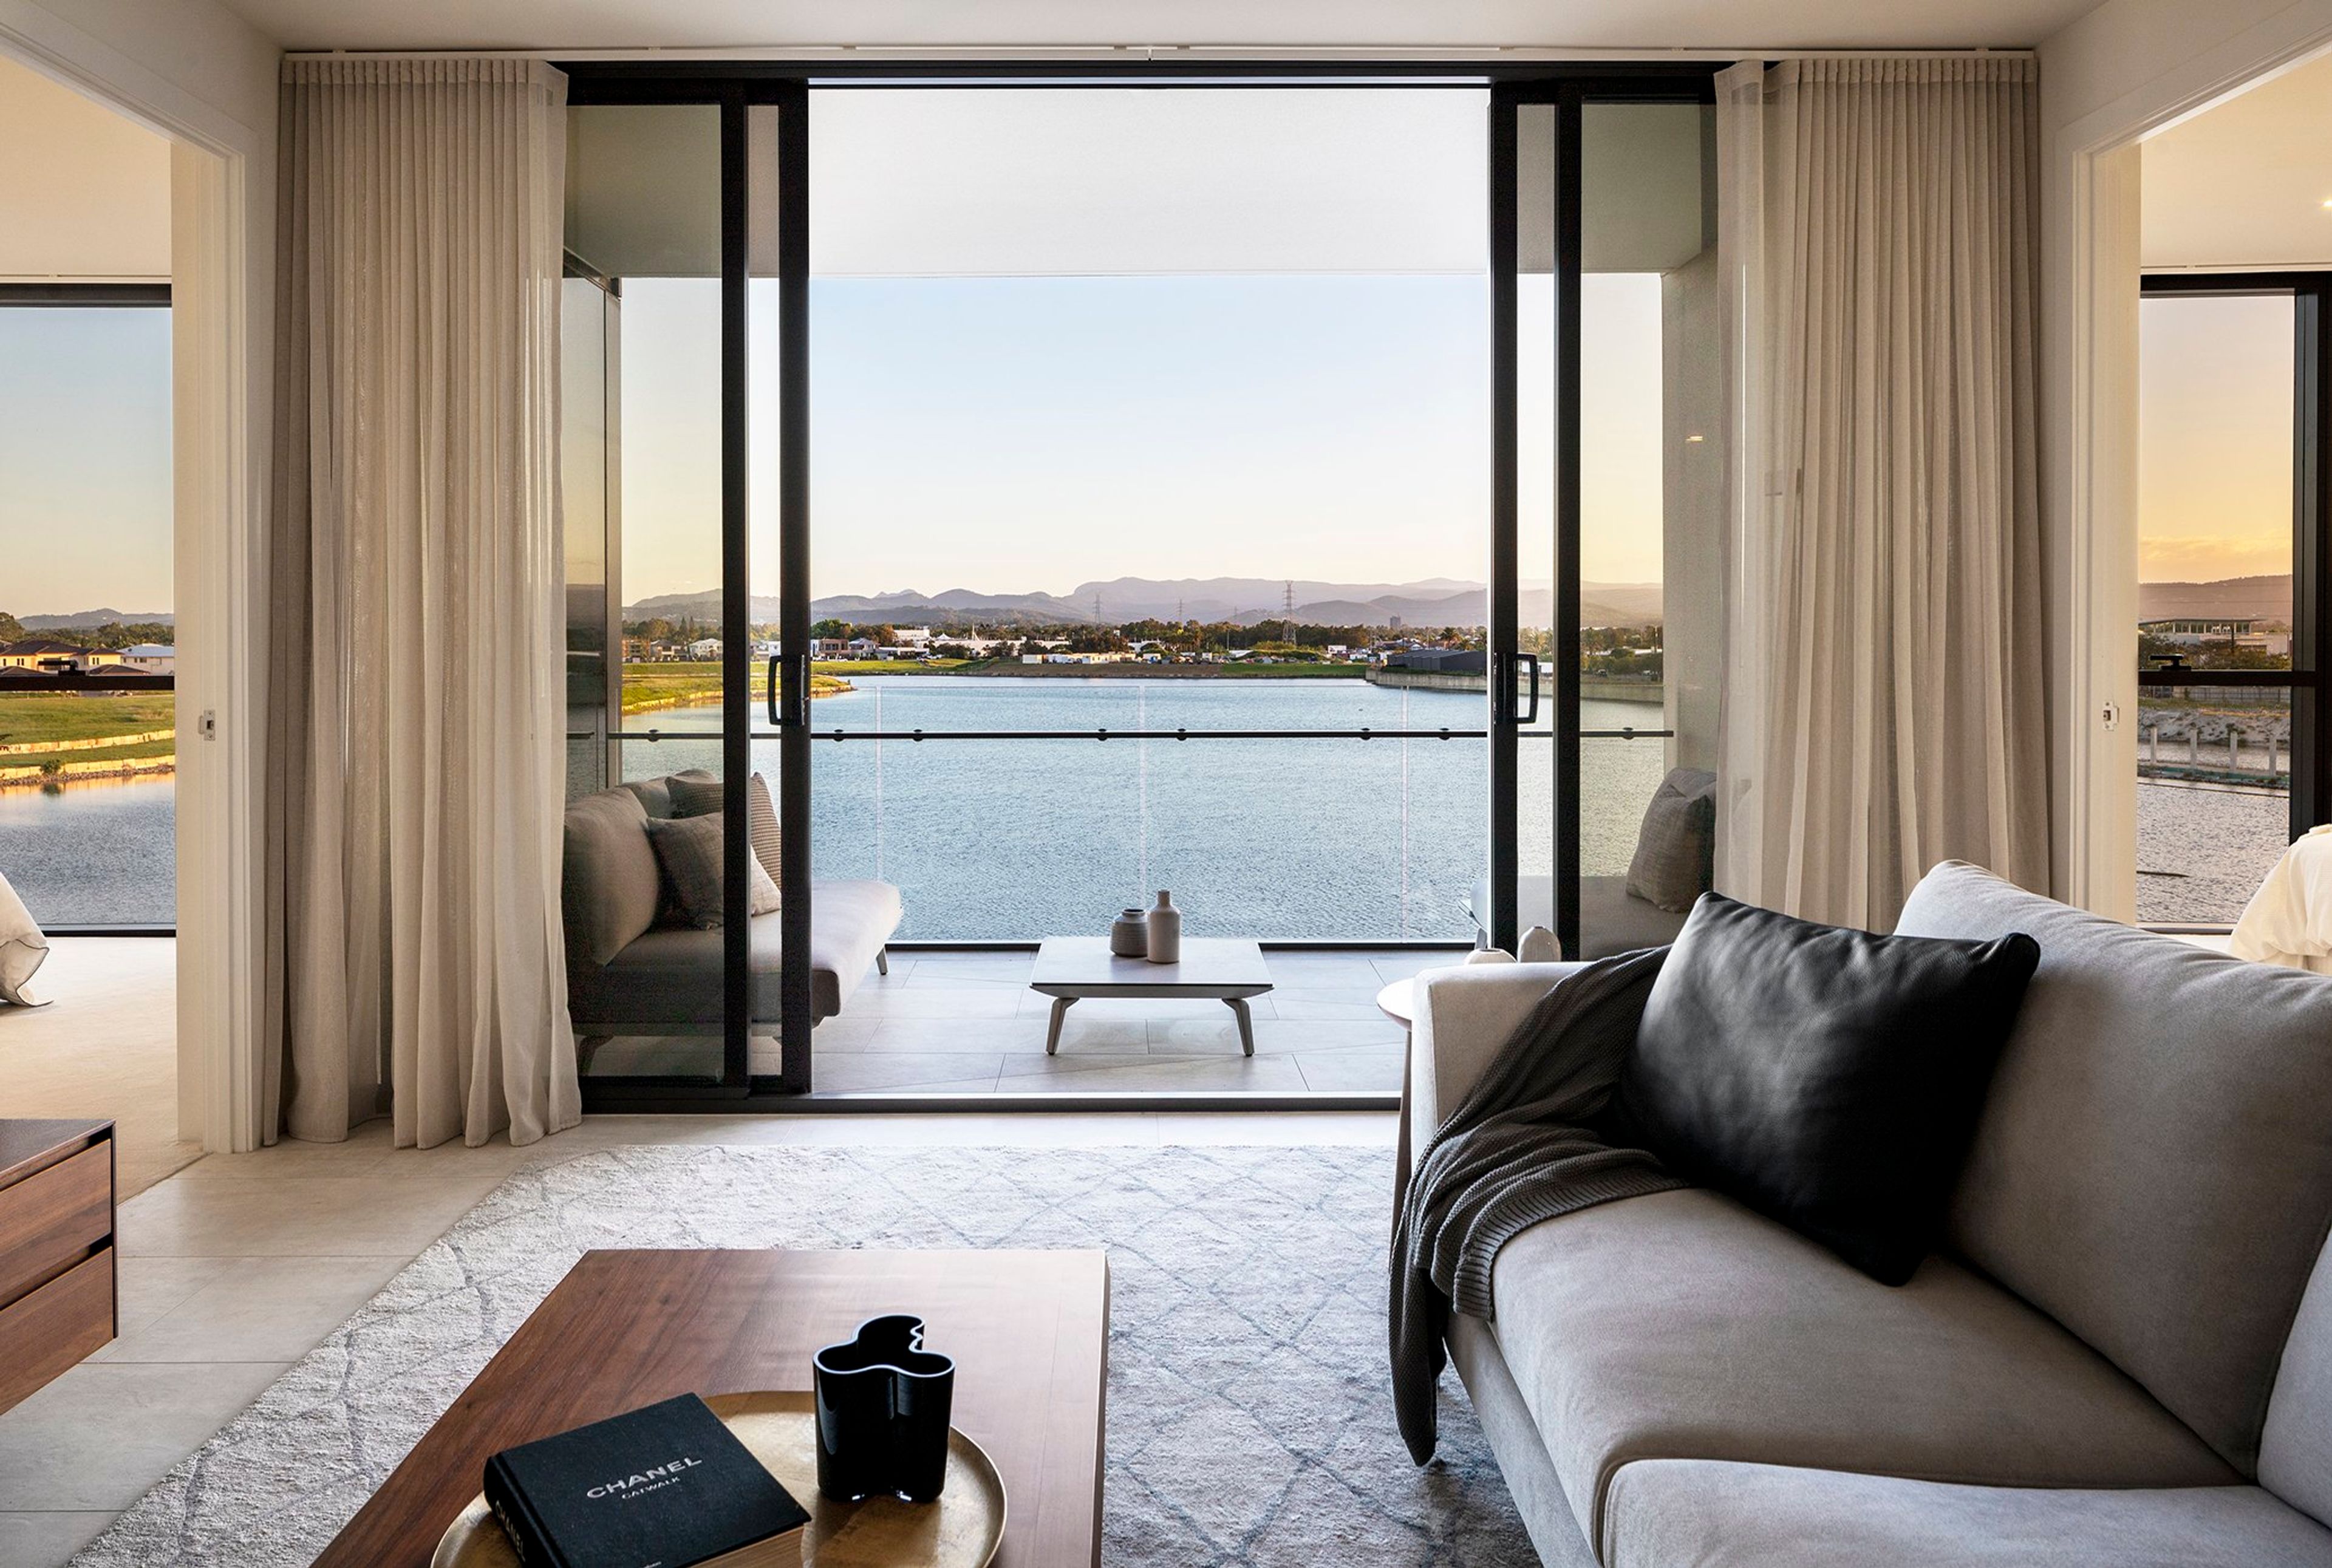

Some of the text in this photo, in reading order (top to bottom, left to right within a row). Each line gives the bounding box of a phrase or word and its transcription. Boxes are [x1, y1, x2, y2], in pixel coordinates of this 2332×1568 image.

[587, 1457, 703, 1498] CHANEL
[621, 1476, 681, 1499] CATWALK
[495, 1499, 526, 1563] CHANEL
